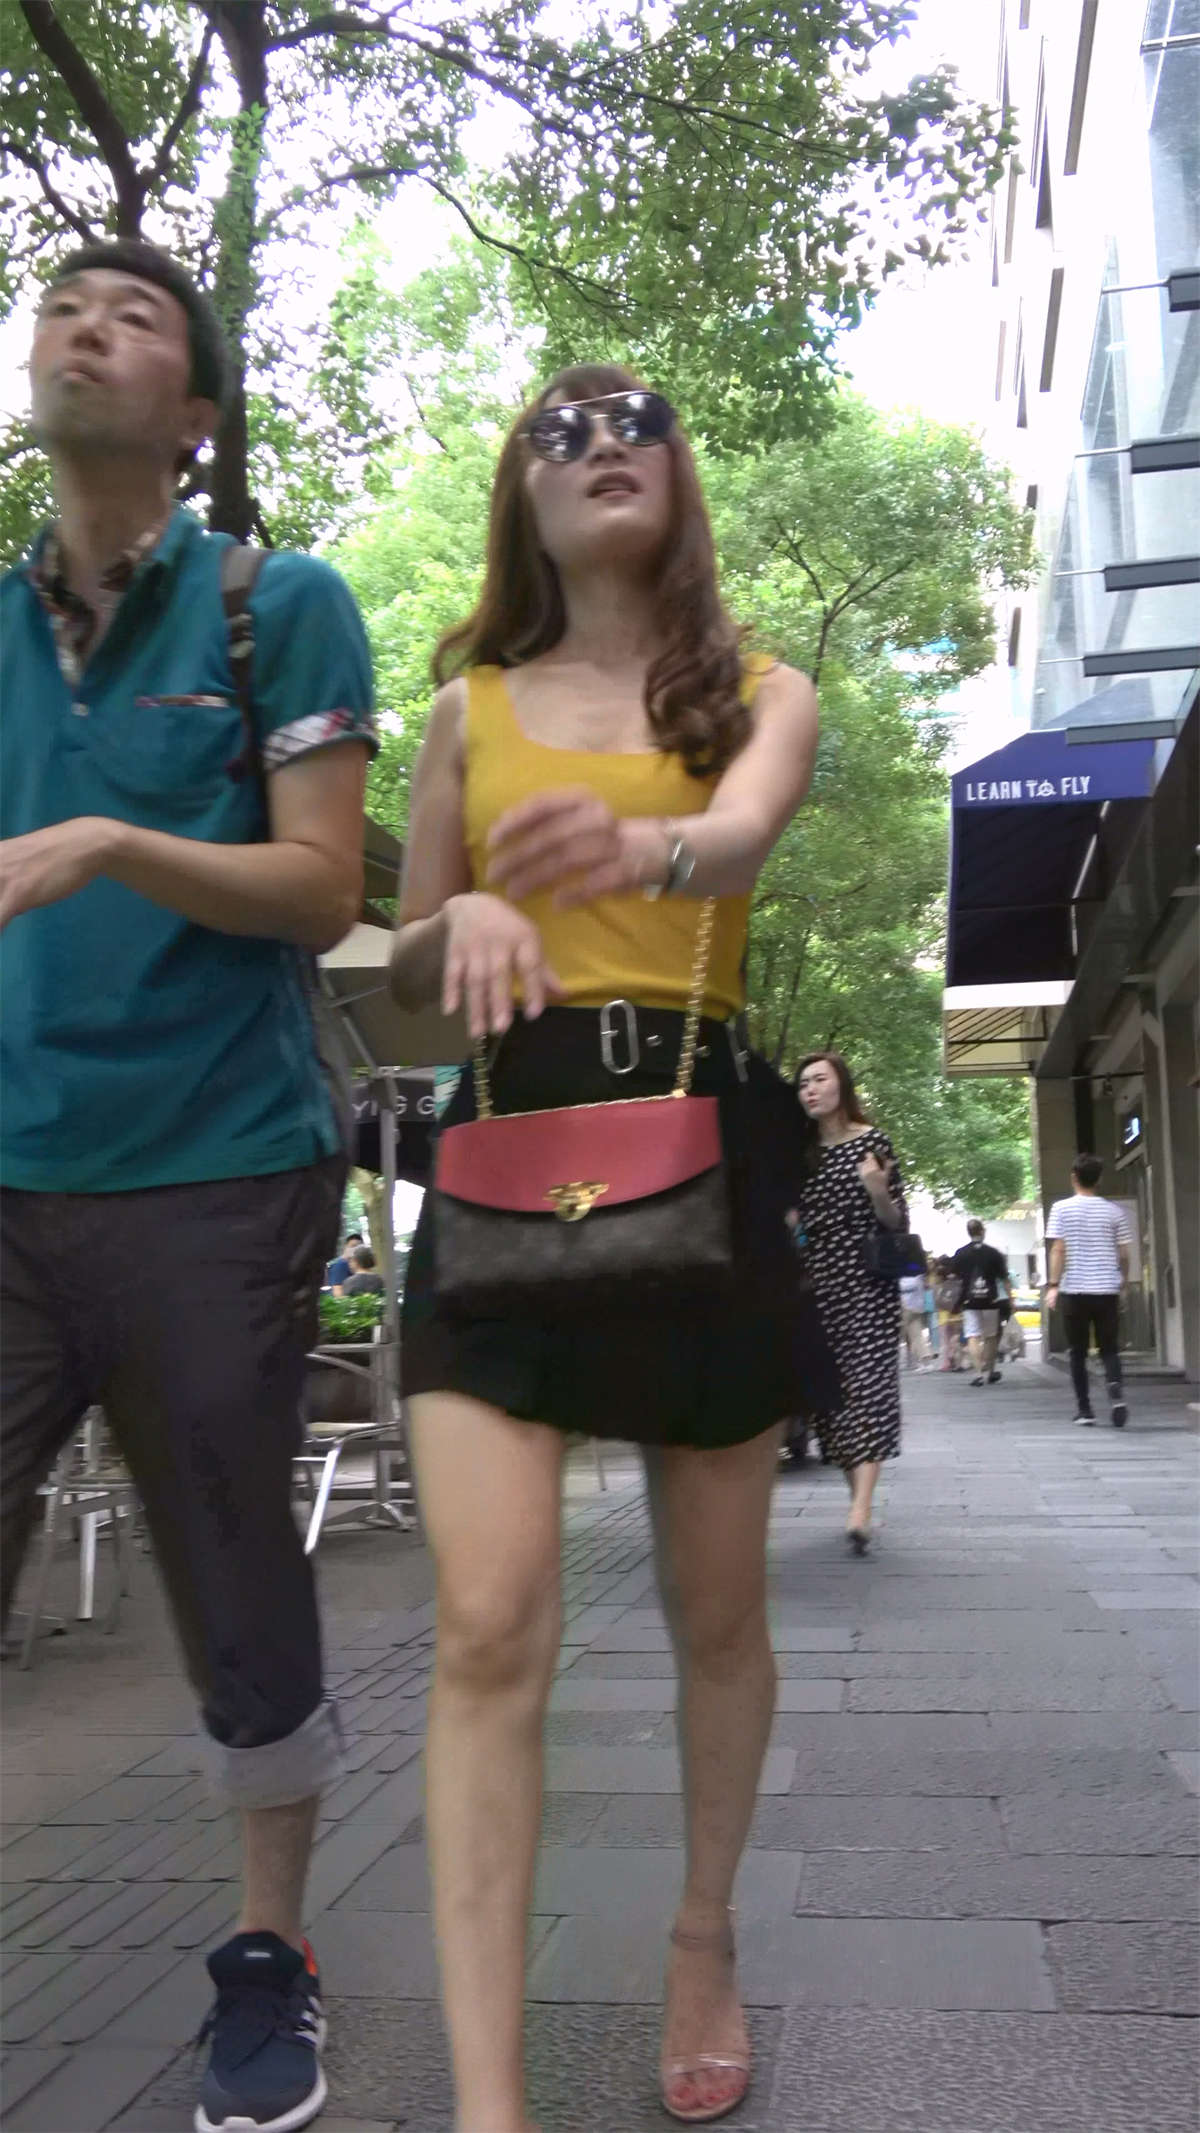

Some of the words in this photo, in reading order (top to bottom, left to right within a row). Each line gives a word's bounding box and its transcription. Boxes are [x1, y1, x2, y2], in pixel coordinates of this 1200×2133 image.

[966, 780, 1022, 801] LEARN
[1025, 779, 1057, 798] TO
[1061, 775, 1090, 796] FLY
